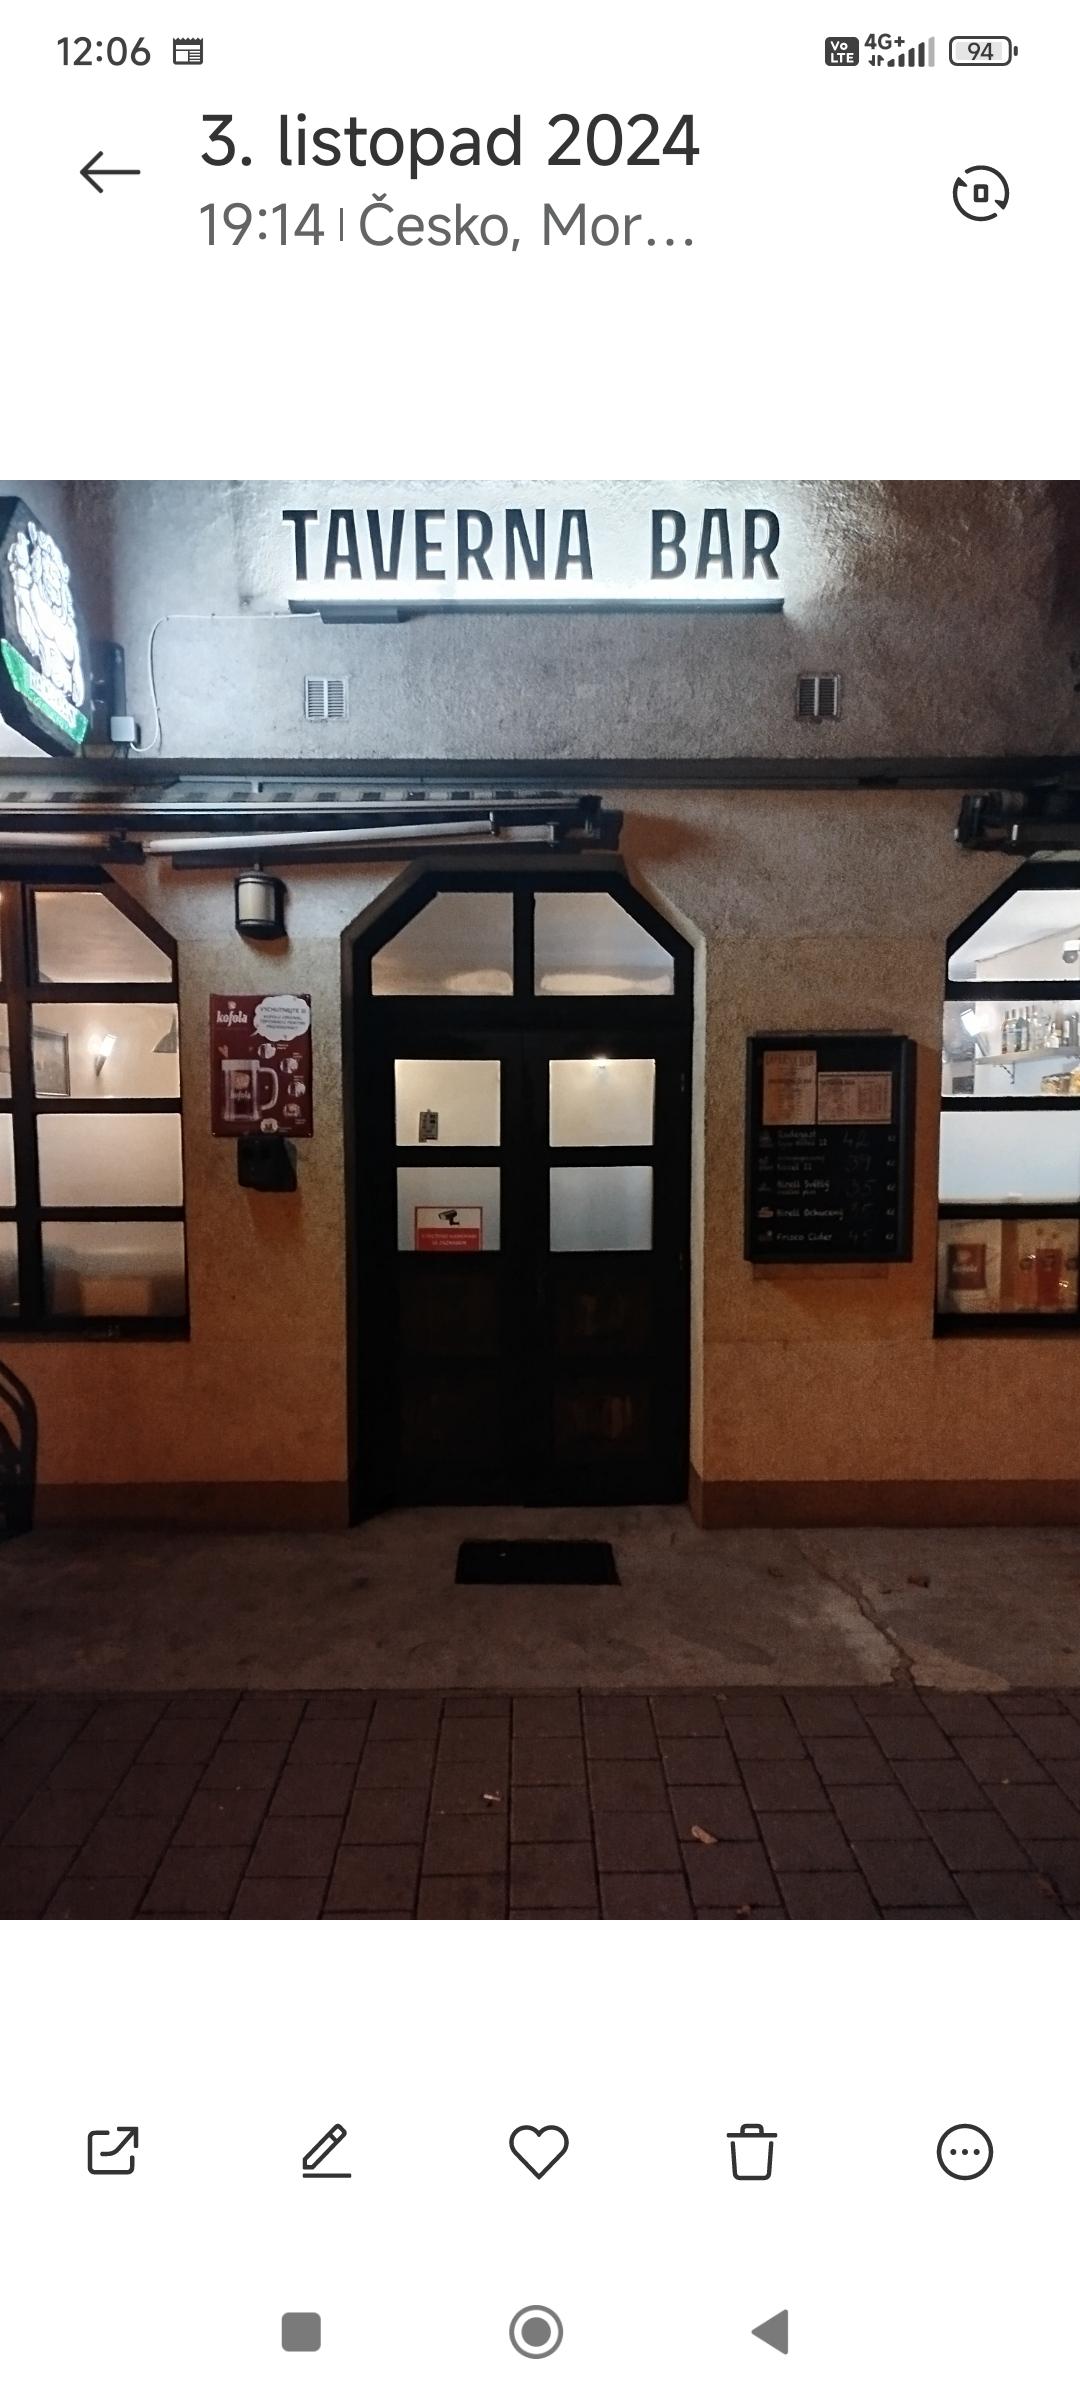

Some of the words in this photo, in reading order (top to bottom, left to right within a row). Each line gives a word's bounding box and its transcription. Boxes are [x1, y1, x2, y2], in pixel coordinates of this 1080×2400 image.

[282, 508, 594, 581] TAVERNA
[650, 508, 780, 581] BAR
[216, 1009, 248, 1027] kofola
